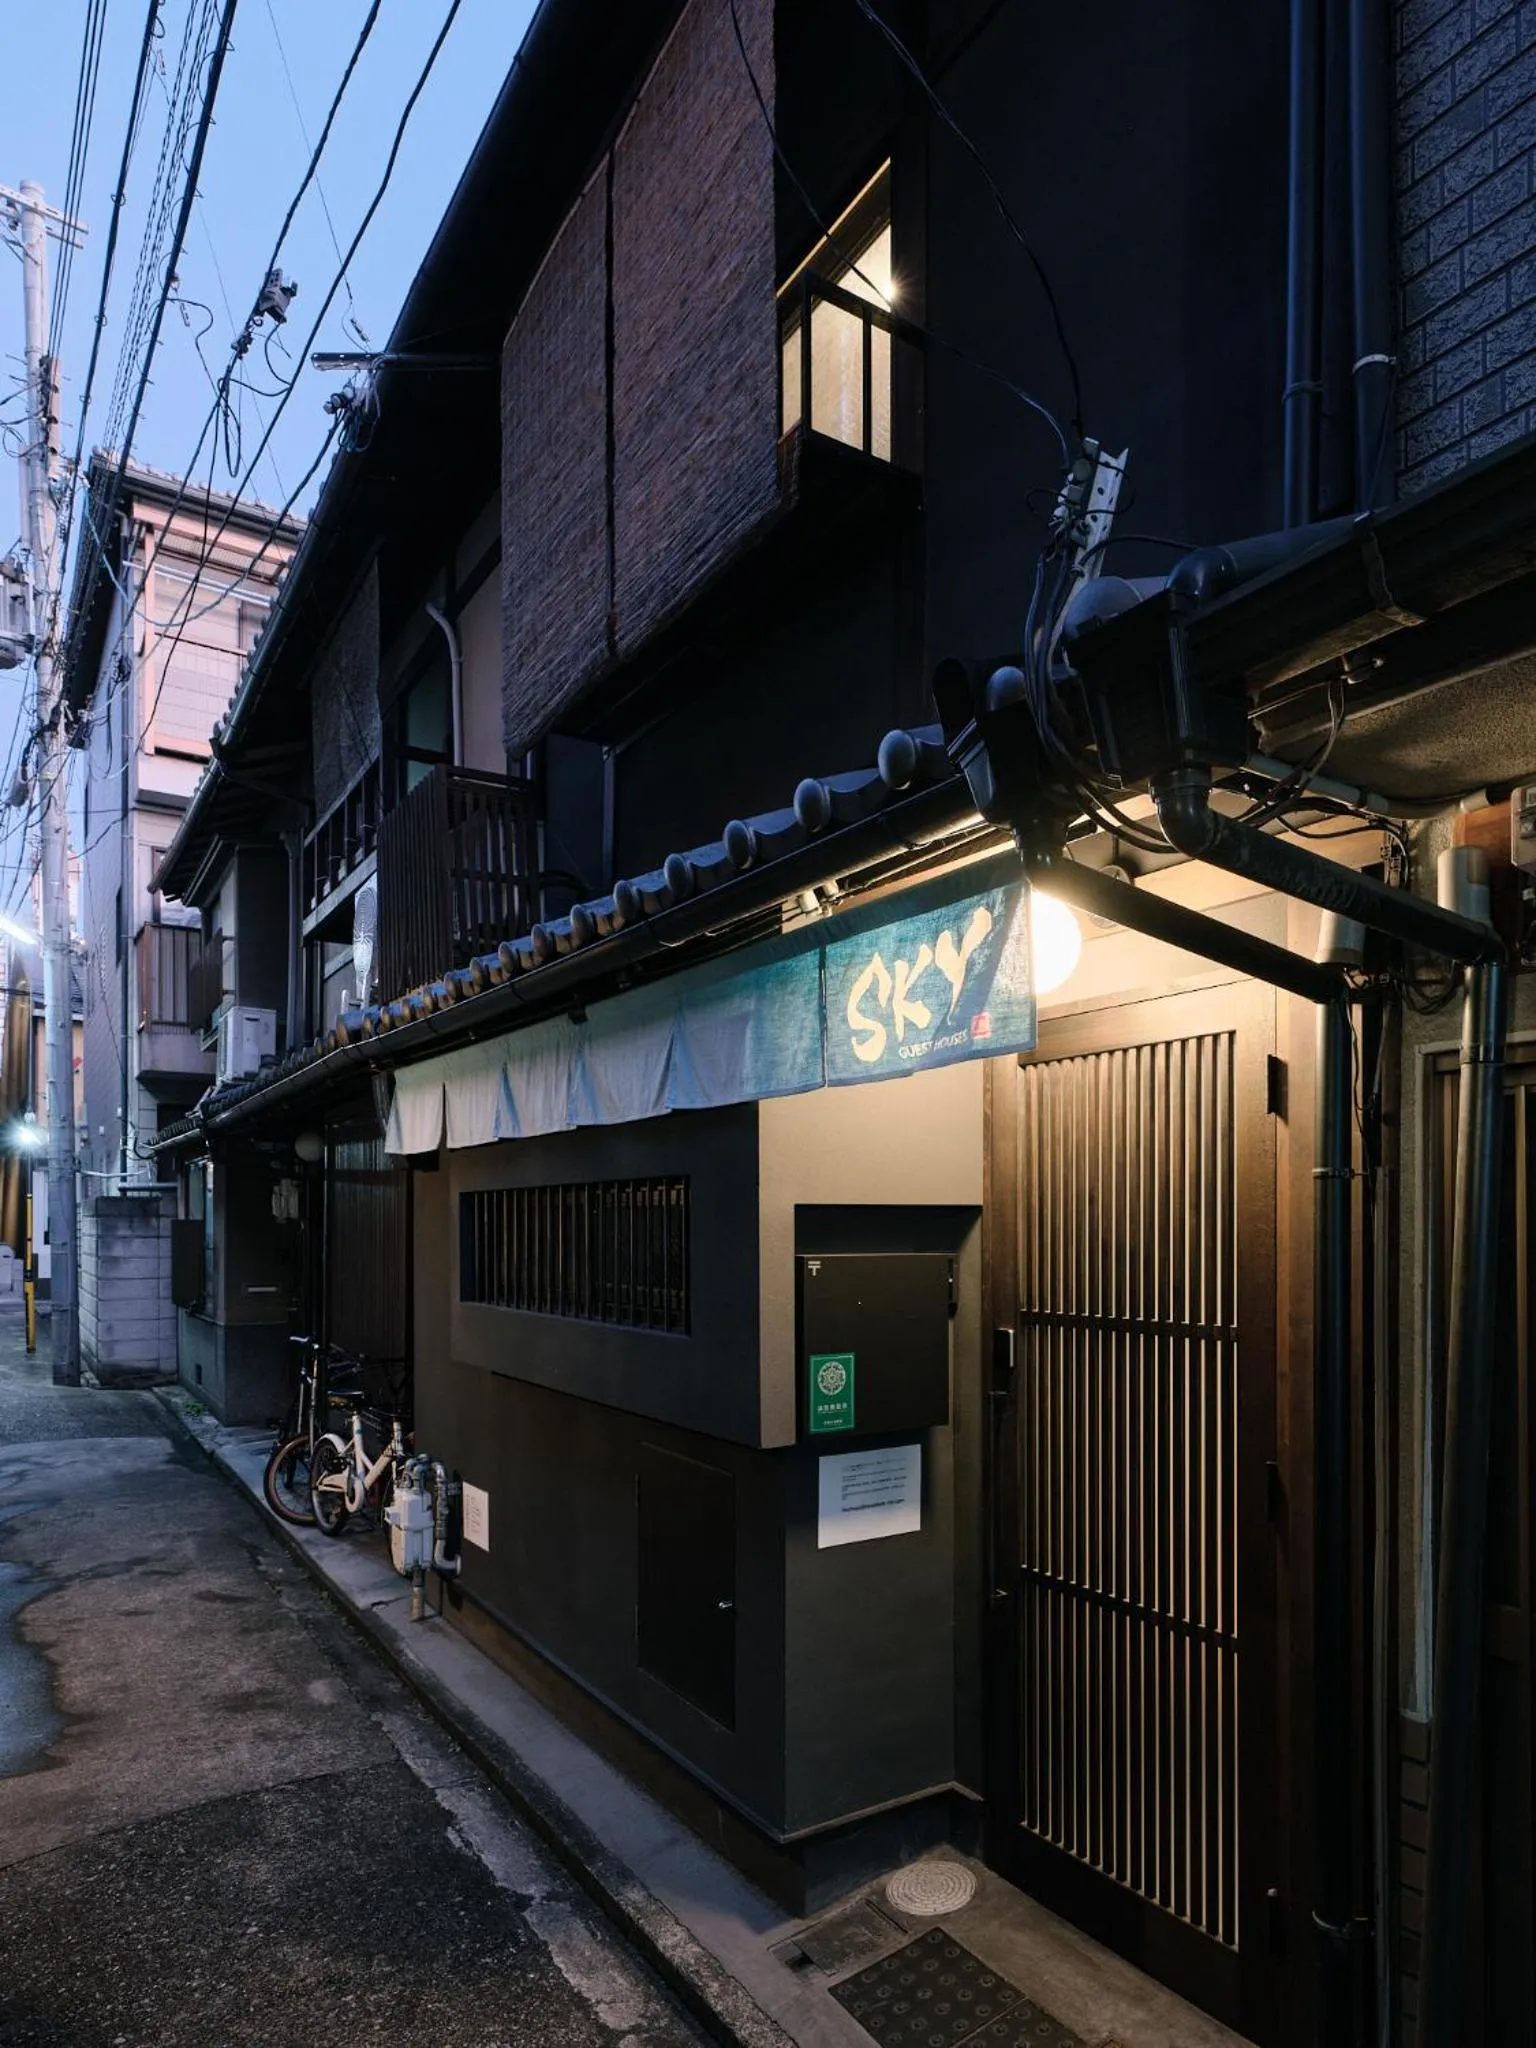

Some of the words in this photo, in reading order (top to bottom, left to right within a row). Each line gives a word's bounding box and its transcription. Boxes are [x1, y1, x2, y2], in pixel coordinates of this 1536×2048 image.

[847, 906, 992, 1063] SKY
[899, 1041, 933, 1059] GUEST
[934, 1029, 968, 1051] HOUSE
